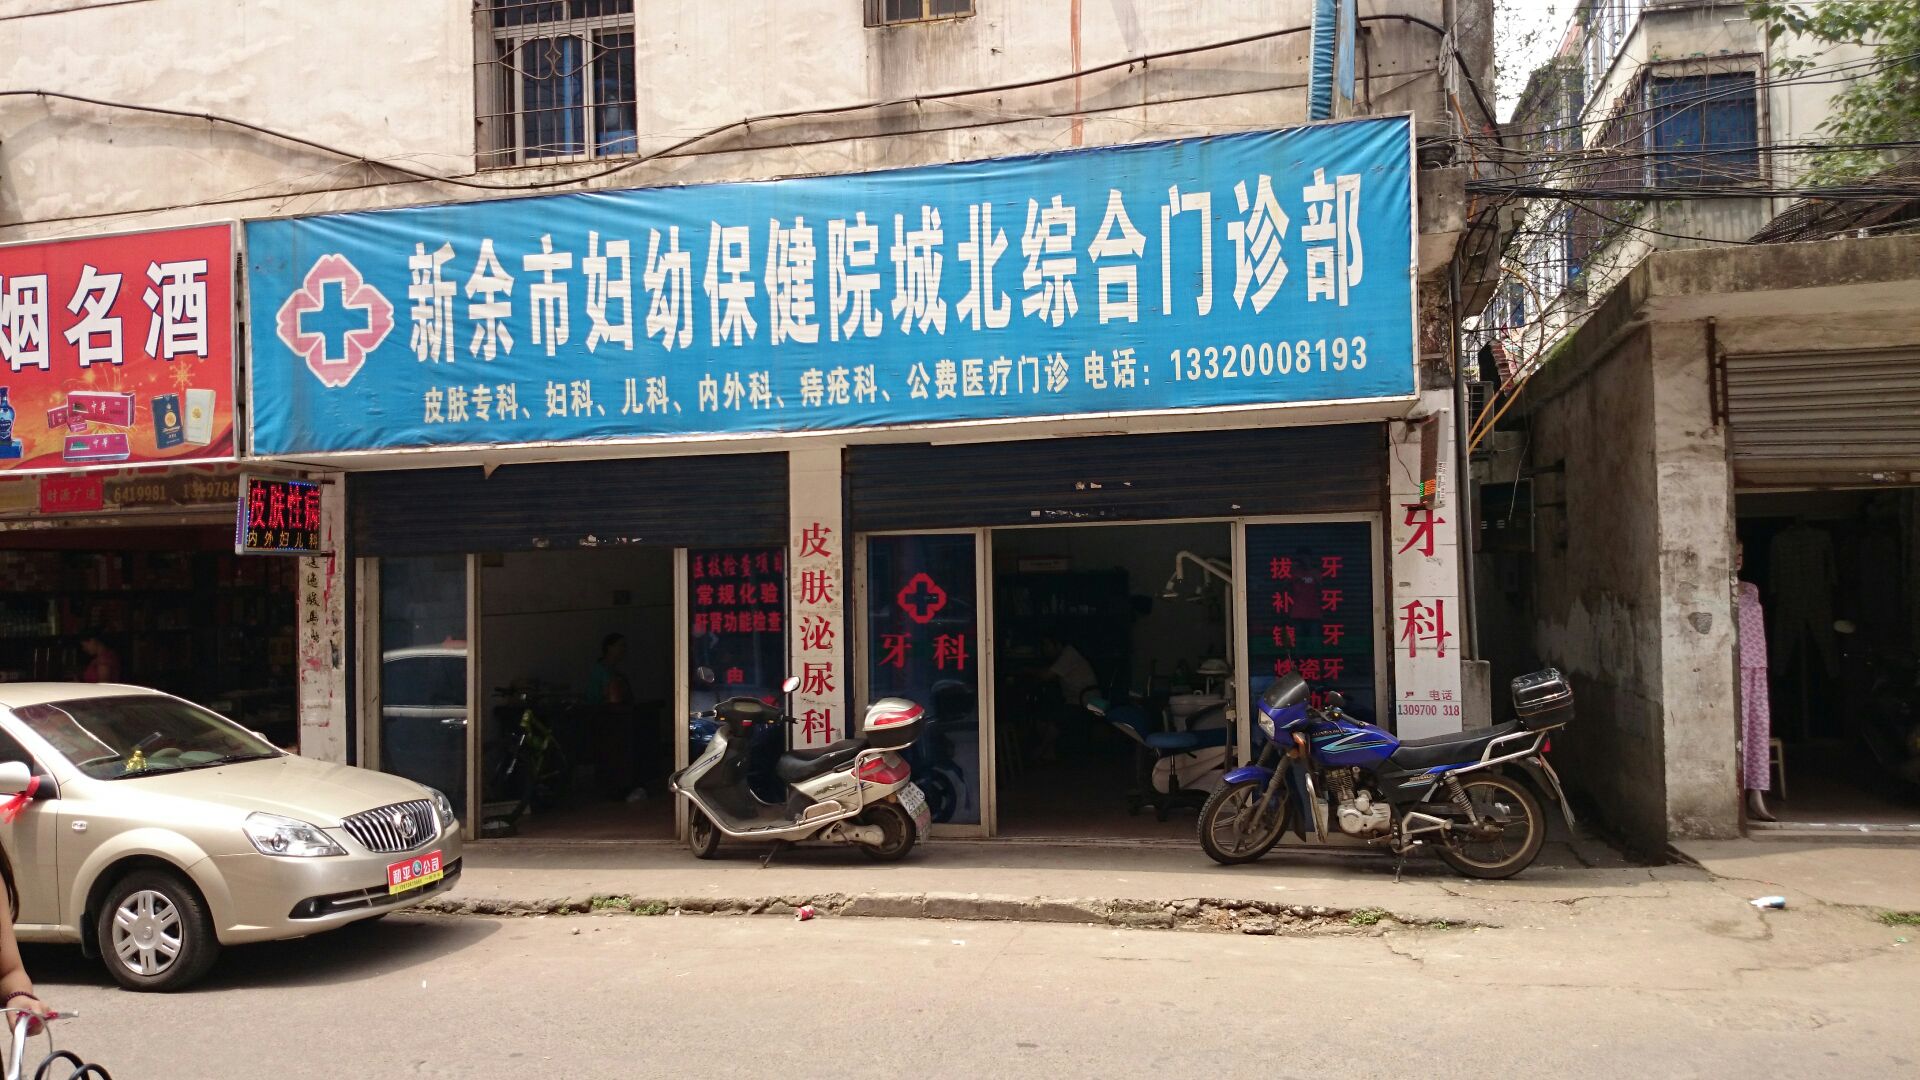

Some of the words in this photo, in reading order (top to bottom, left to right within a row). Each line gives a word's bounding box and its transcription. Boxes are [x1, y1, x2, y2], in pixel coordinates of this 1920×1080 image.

[408, 167, 1362, 364] 新余市妇幼保健院城北综合门诊部
[0, 259, 209, 372] 烟名酒
[1170, 335, 1367, 382] 13320008193
[249, 480, 320, 530] 皮肤性病
[1270, 556, 1344, 579] 拔牙
[1398, 502, 1452, 659] 牙科
[696, 582, 779, 606] 常规化验
[1271, 589, 1344, 613] 补牙
[693, 610, 782, 635] 肝肾功能检查
[799, 522, 836, 744] 皮肤泌尿科
[879, 632, 970, 671] 牙科
[1429, 689, 1453, 701] 电话
